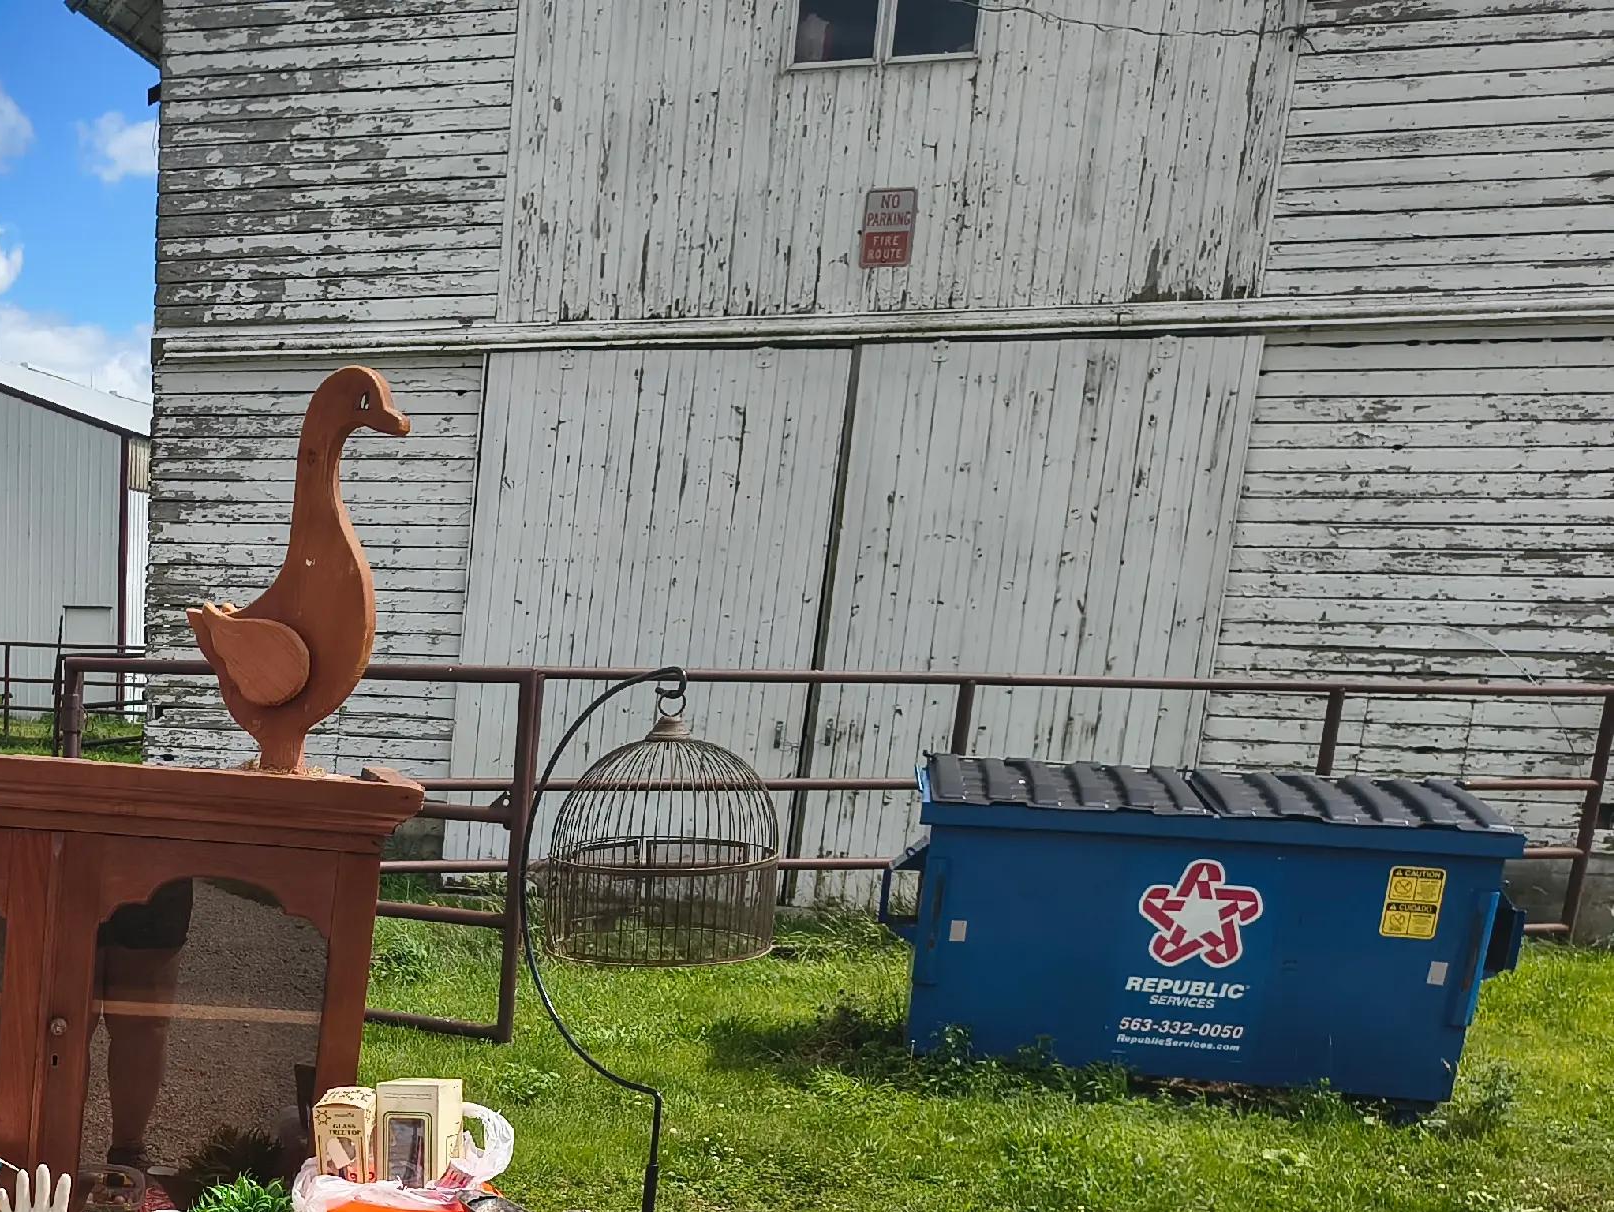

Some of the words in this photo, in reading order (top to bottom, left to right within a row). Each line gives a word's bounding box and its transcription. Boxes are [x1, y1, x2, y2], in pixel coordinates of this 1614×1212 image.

[880, 194, 900, 209] NO
[866, 212, 912, 227] PARKING
[873, 235, 899, 246] FIRE
[867, 248, 902, 260] ROUTE
[1404, 869, 1442, 879] CAUTION
[1125, 976, 1246, 999] REPUBLIC
[1149, 994, 1215, 1009] SERVICES
[1118, 1016, 1244, 1039] 563-332-0050
[1116, 1033, 1240, 1052] RepublicServices.com
